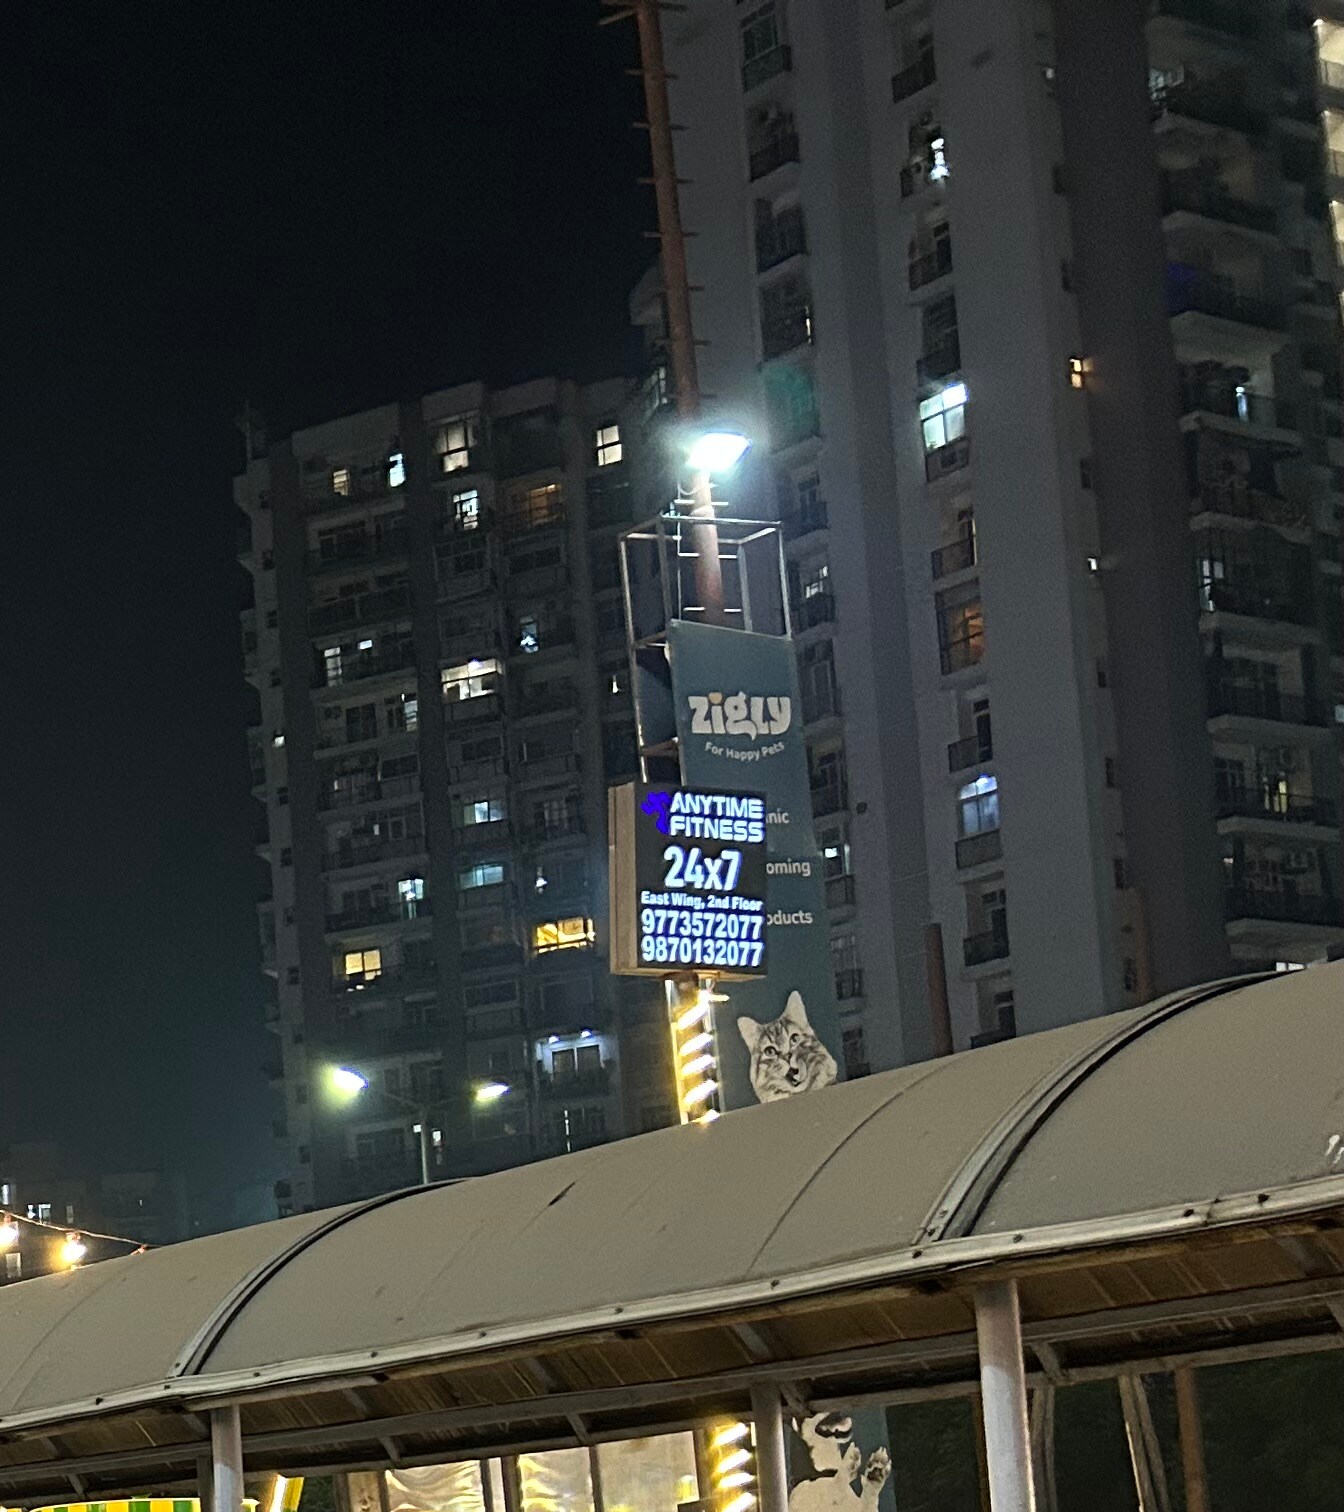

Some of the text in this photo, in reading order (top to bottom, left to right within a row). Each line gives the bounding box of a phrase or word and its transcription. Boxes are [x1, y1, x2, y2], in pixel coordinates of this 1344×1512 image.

[705, 741, 785, 762] For Happy Pets
[670, 792, 764, 819] ANYTIME
[670, 815, 764, 843] FITNESS
[664, 845, 742, 891] 24x7
[641, 890, 764, 911] East Wing, 2nd Floor
[641, 908, 764, 940] 9773572077
[641, 935, 764, 967] 9870132077
